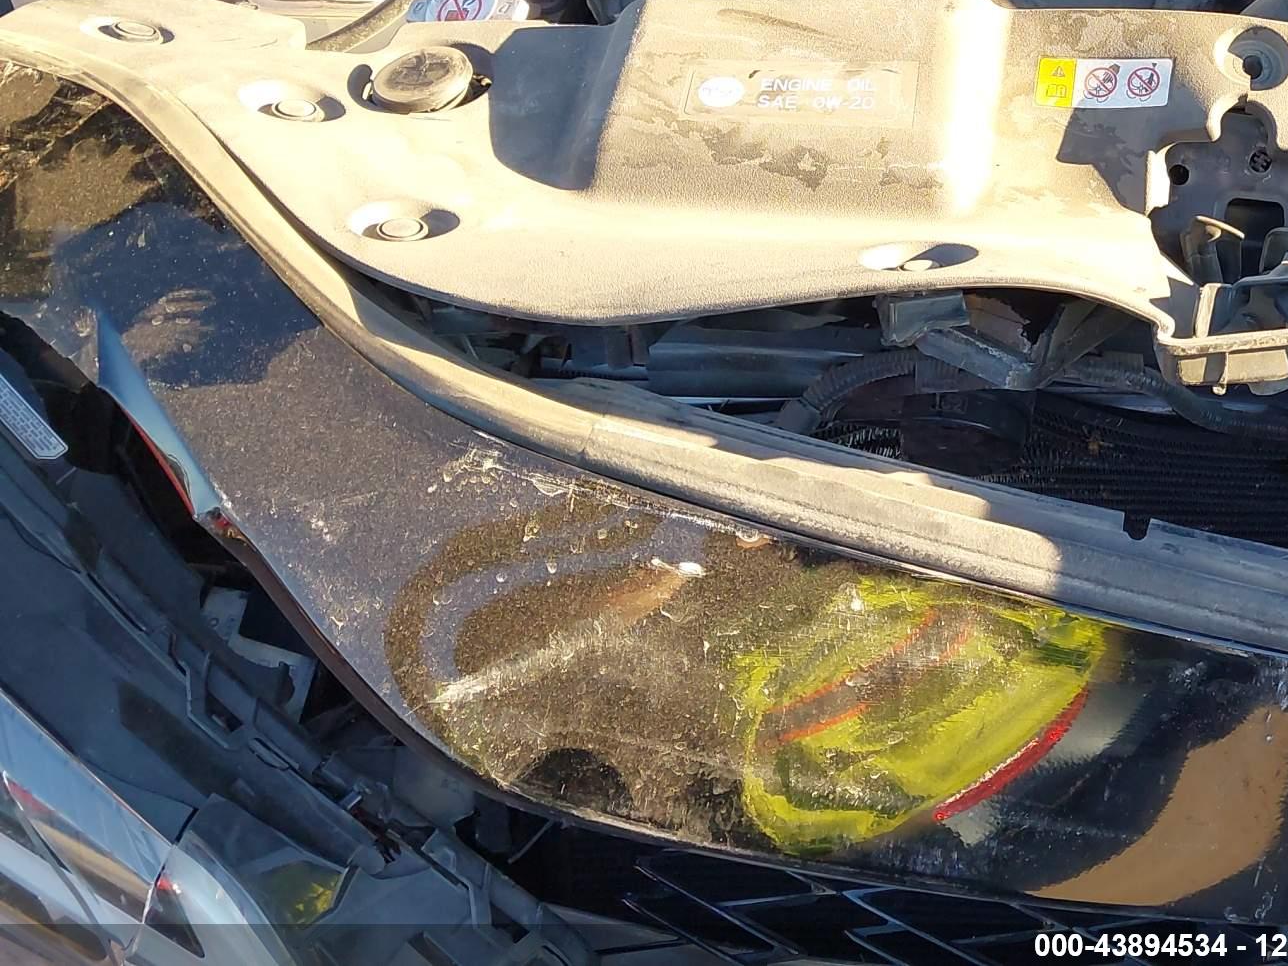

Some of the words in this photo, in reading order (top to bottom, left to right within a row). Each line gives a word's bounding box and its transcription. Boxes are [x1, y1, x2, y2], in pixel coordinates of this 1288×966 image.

[760, 78, 833, 92] ENGINE
[847, 78, 877, 92] OIL
[757, 95, 797, 109] SAE
